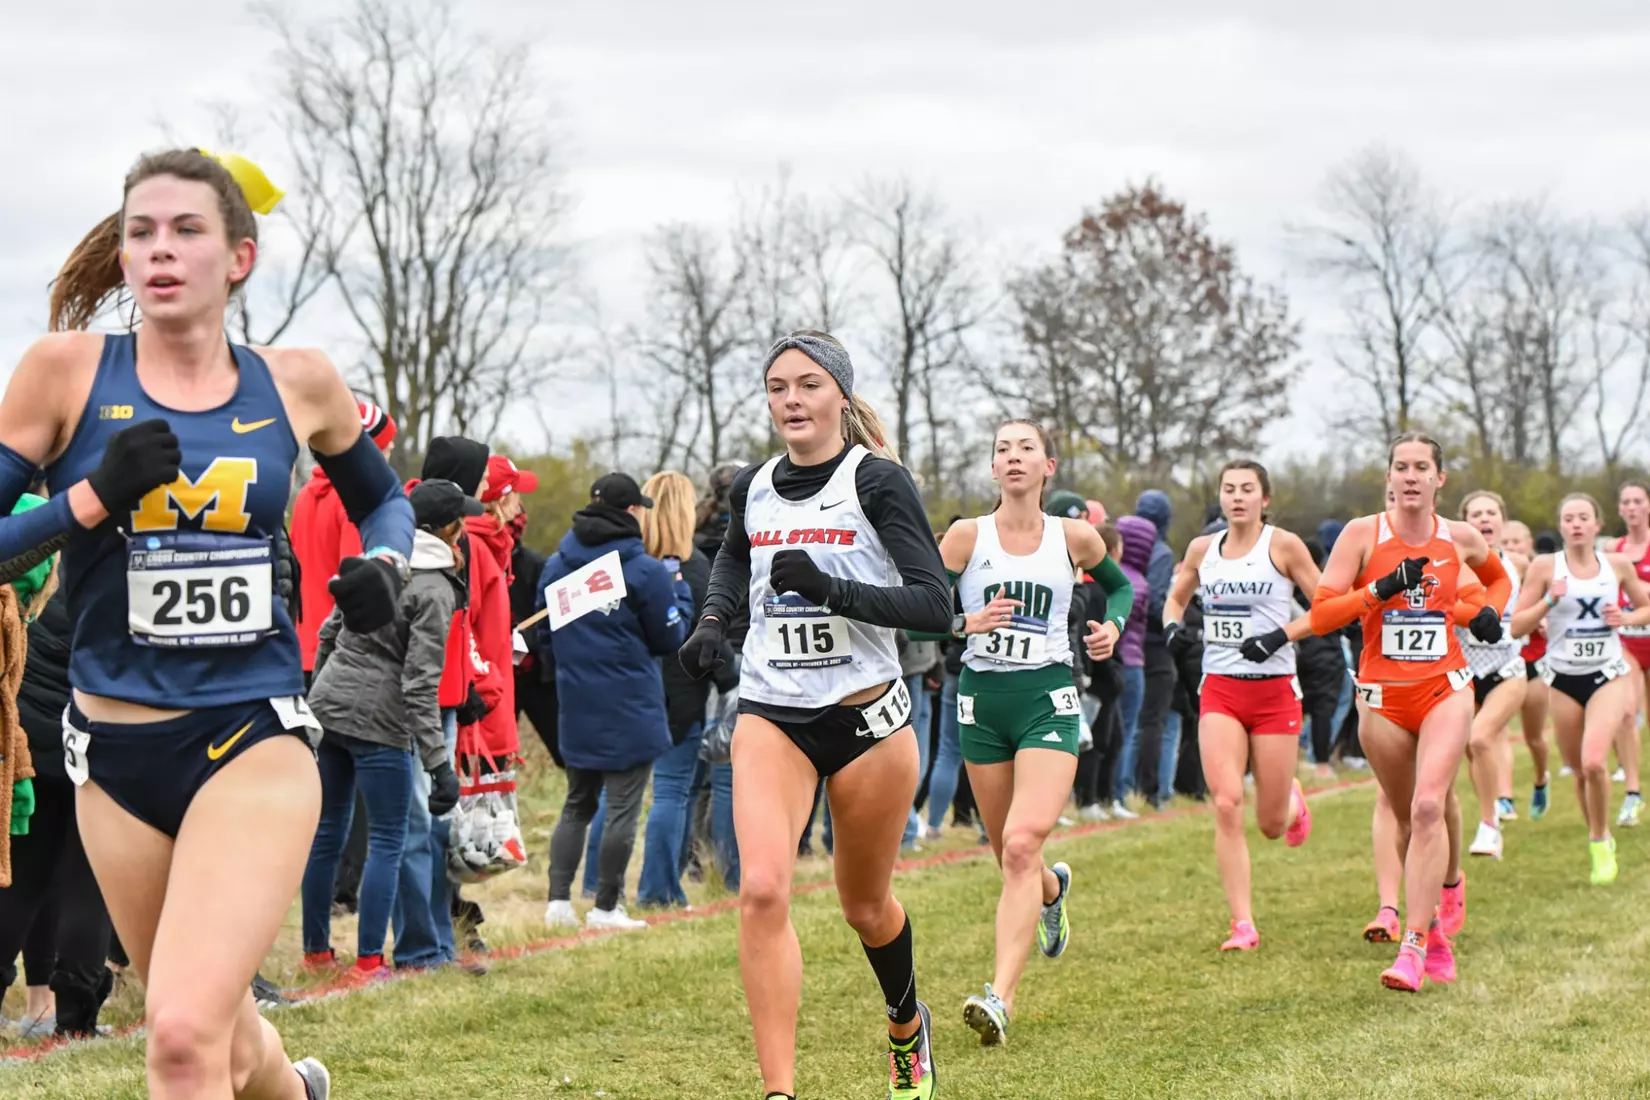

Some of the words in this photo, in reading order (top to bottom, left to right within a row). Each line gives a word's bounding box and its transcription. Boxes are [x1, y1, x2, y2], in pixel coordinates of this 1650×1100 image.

[131, 456, 258, 533] M
[786, 528, 857, 546] STATE
[152, 576, 250, 625] 256
[1576, 597, 1601, 620] X
[778, 622, 834, 654] 115
[1212, 620, 1243, 639] 153
[1394, 629, 1437, 651] 127
[985, 631, 1031, 660] 311
[1573, 641, 1605, 657] 397
[878, 684, 909, 728] 115
